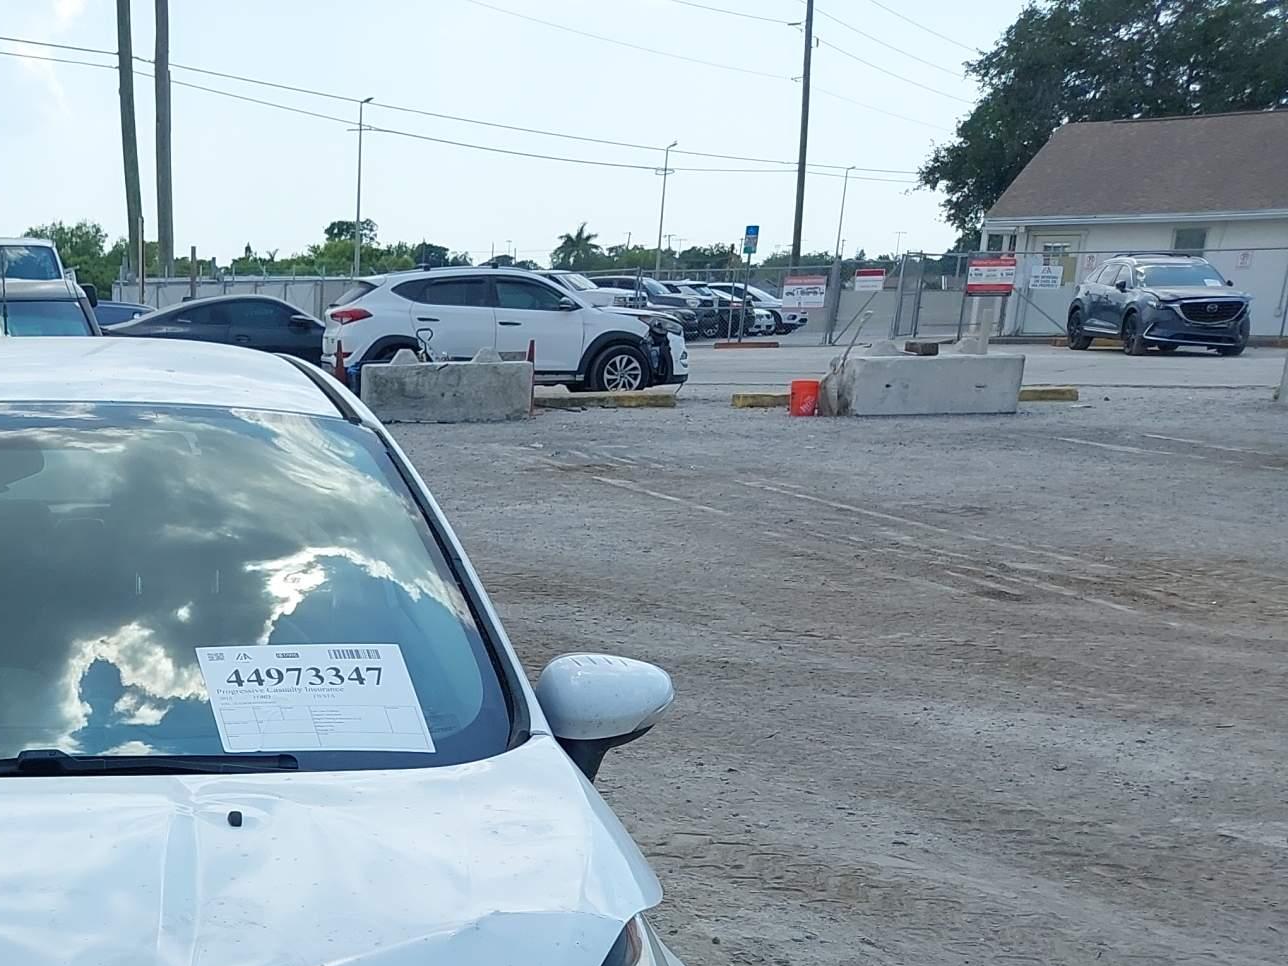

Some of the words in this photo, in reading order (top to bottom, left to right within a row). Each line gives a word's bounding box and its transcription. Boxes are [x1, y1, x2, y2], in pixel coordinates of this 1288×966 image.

[226, 666, 383, 687] 44973347
[216, 687, 265, 696] Progressive
[266, 686, 303, 694] Casualty
